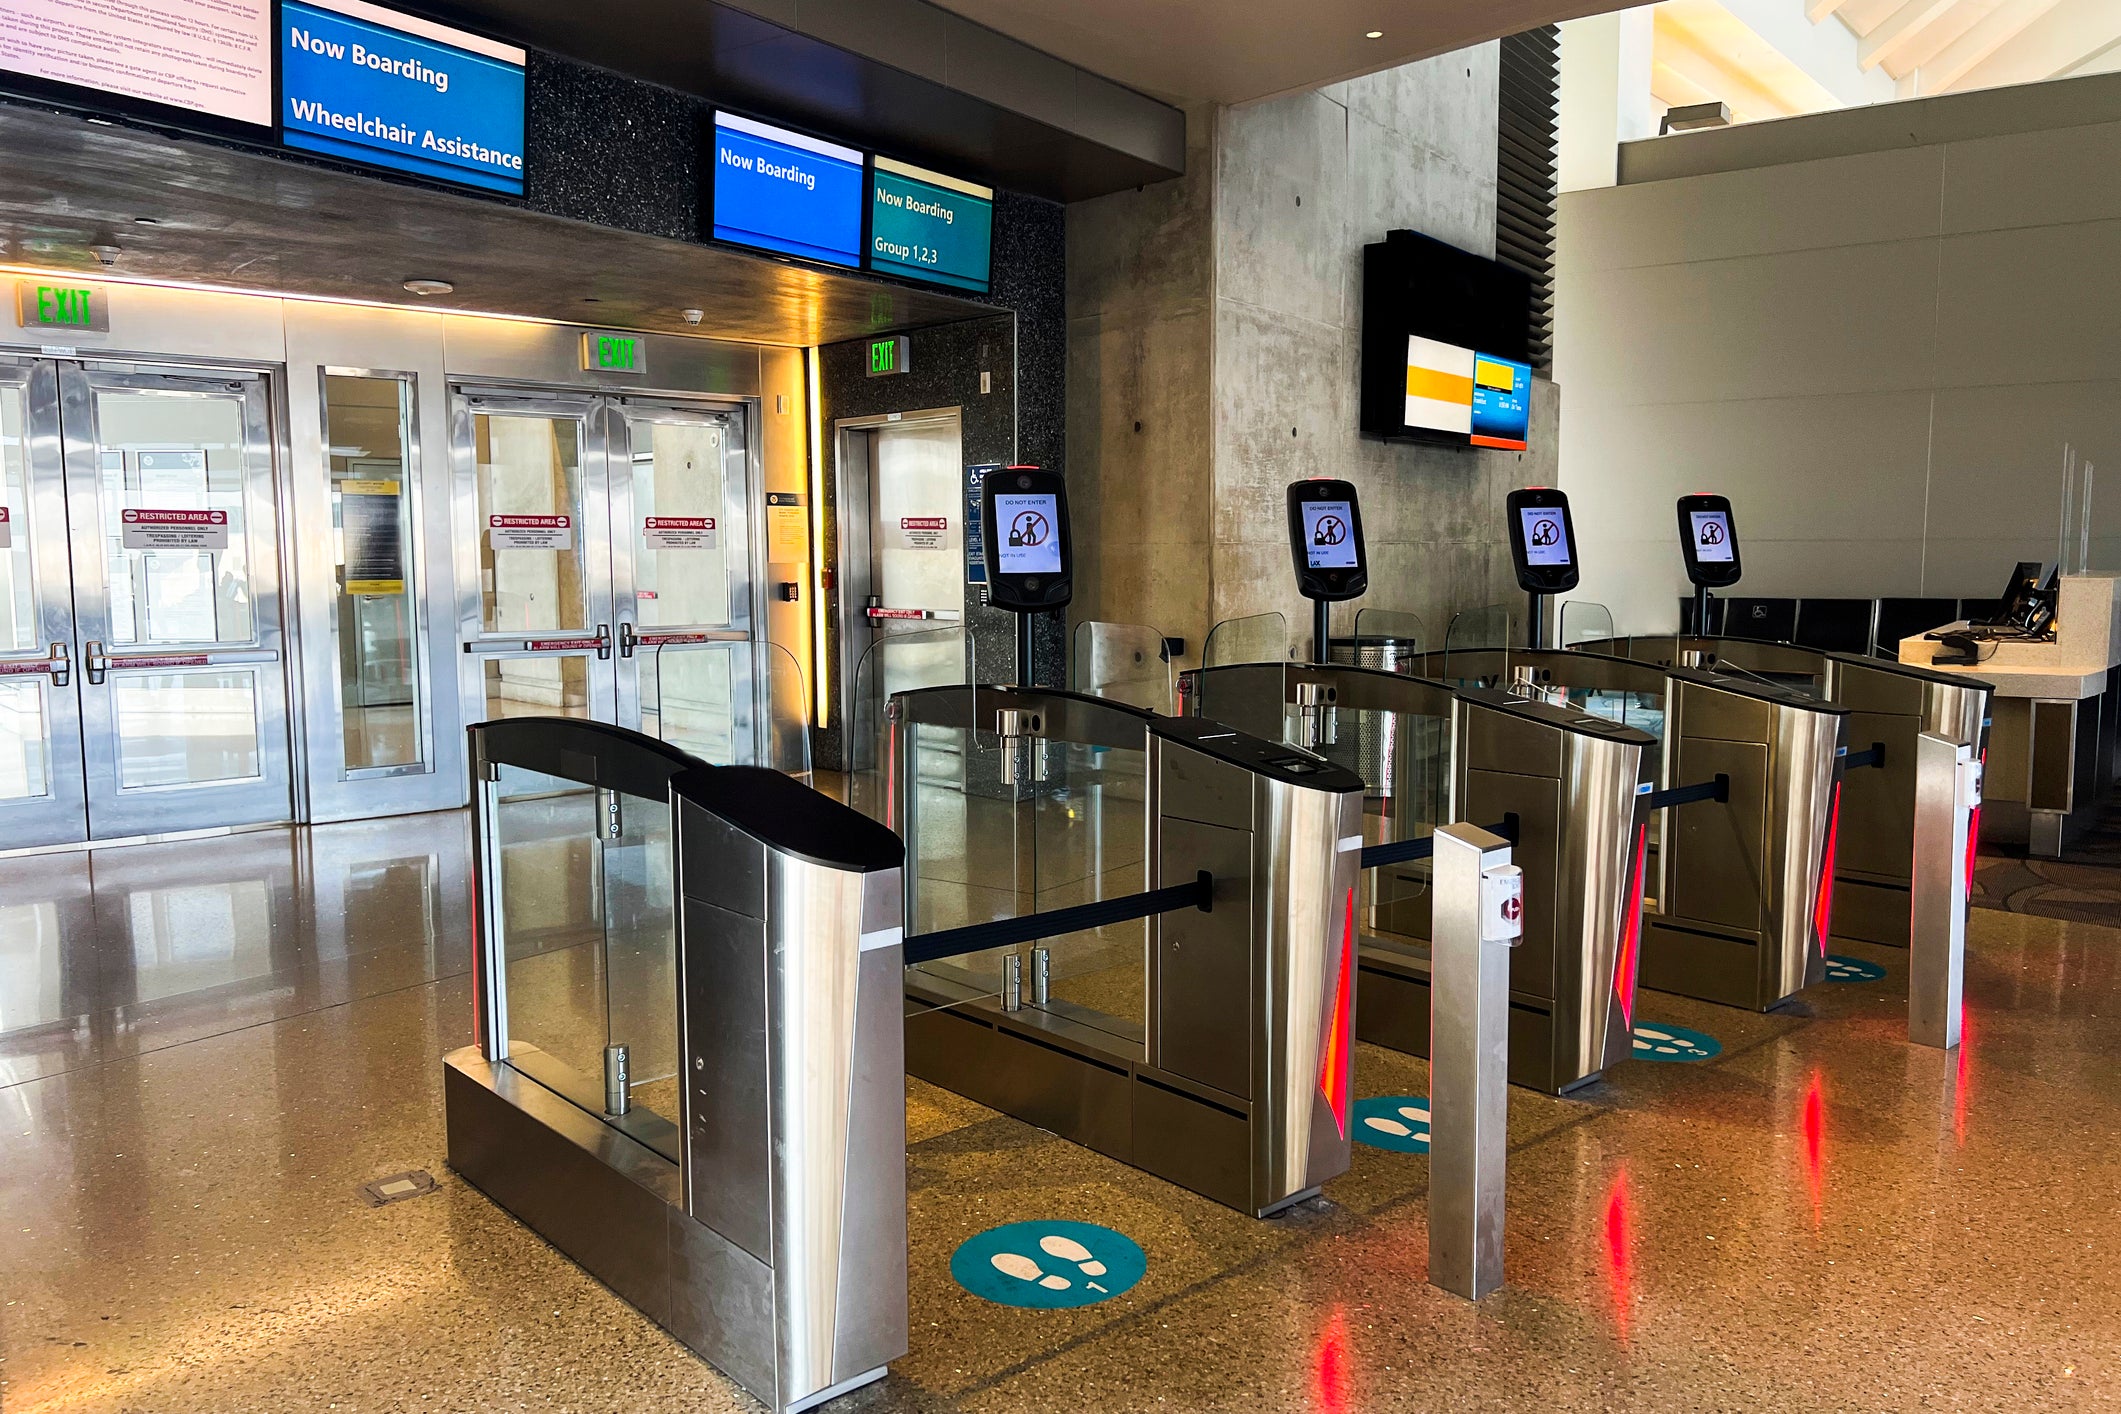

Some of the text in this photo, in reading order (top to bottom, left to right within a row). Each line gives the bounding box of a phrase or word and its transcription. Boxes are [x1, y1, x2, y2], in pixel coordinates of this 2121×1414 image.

[291, 27, 448, 93] Now Boarding
[290, 97, 522, 170] Wheelchair Assistance
[720, 148, 816, 191] Now Boarding
[877, 187, 954, 225] Now Boarding
[874, 236, 938, 264] Group 1,2,3
[37, 286, 92, 325] EXIT
[598, 336, 635, 369] EXIT
[872, 340, 894, 372] EXIT
[140, 512, 186, 520] RESTRICTED
[1688, 1048, 1708, 1056] 3
[1086, 1282, 1108, 1293] 1
